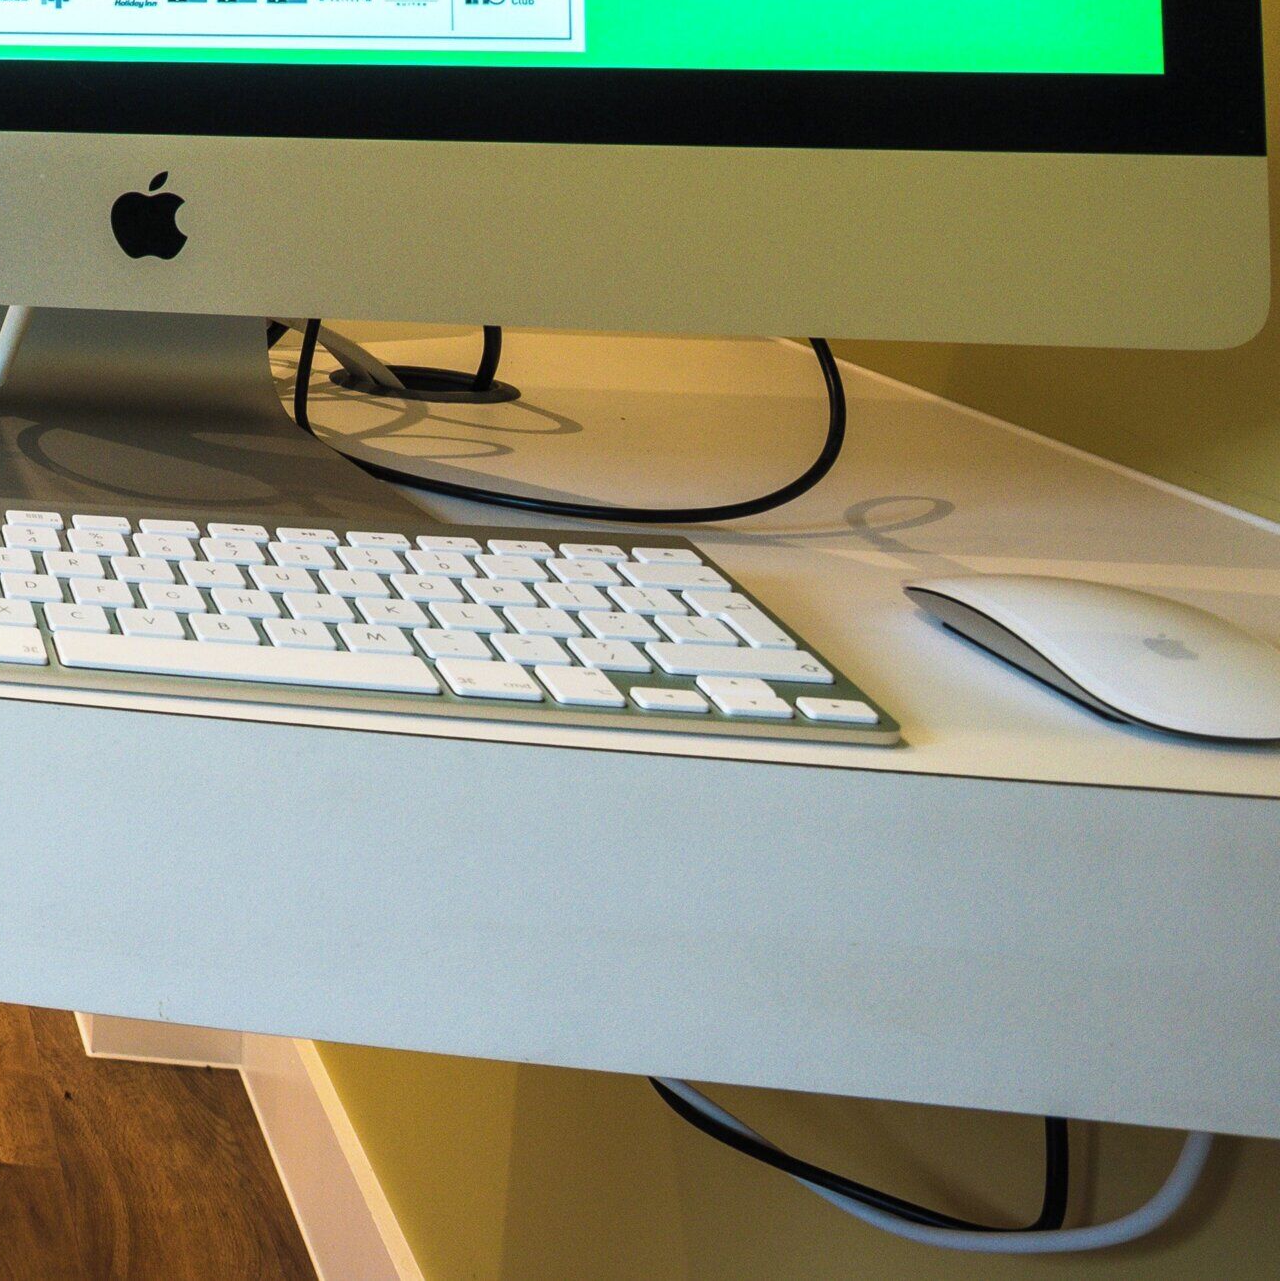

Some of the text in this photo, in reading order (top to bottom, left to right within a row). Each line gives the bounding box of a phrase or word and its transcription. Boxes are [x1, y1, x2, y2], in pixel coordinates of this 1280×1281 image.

[115, 0, 144, 8] Holiday
[275, 573, 290, 581] U
[25, 581, 37, 589] D
[238, 596, 253, 605] H
[385, 605, 400, 614] K
[70, 611, 84, 619] C
[218, 622, 230, 631] B
[291, 627, 308, 636] N
[366, 632, 387, 642] M
